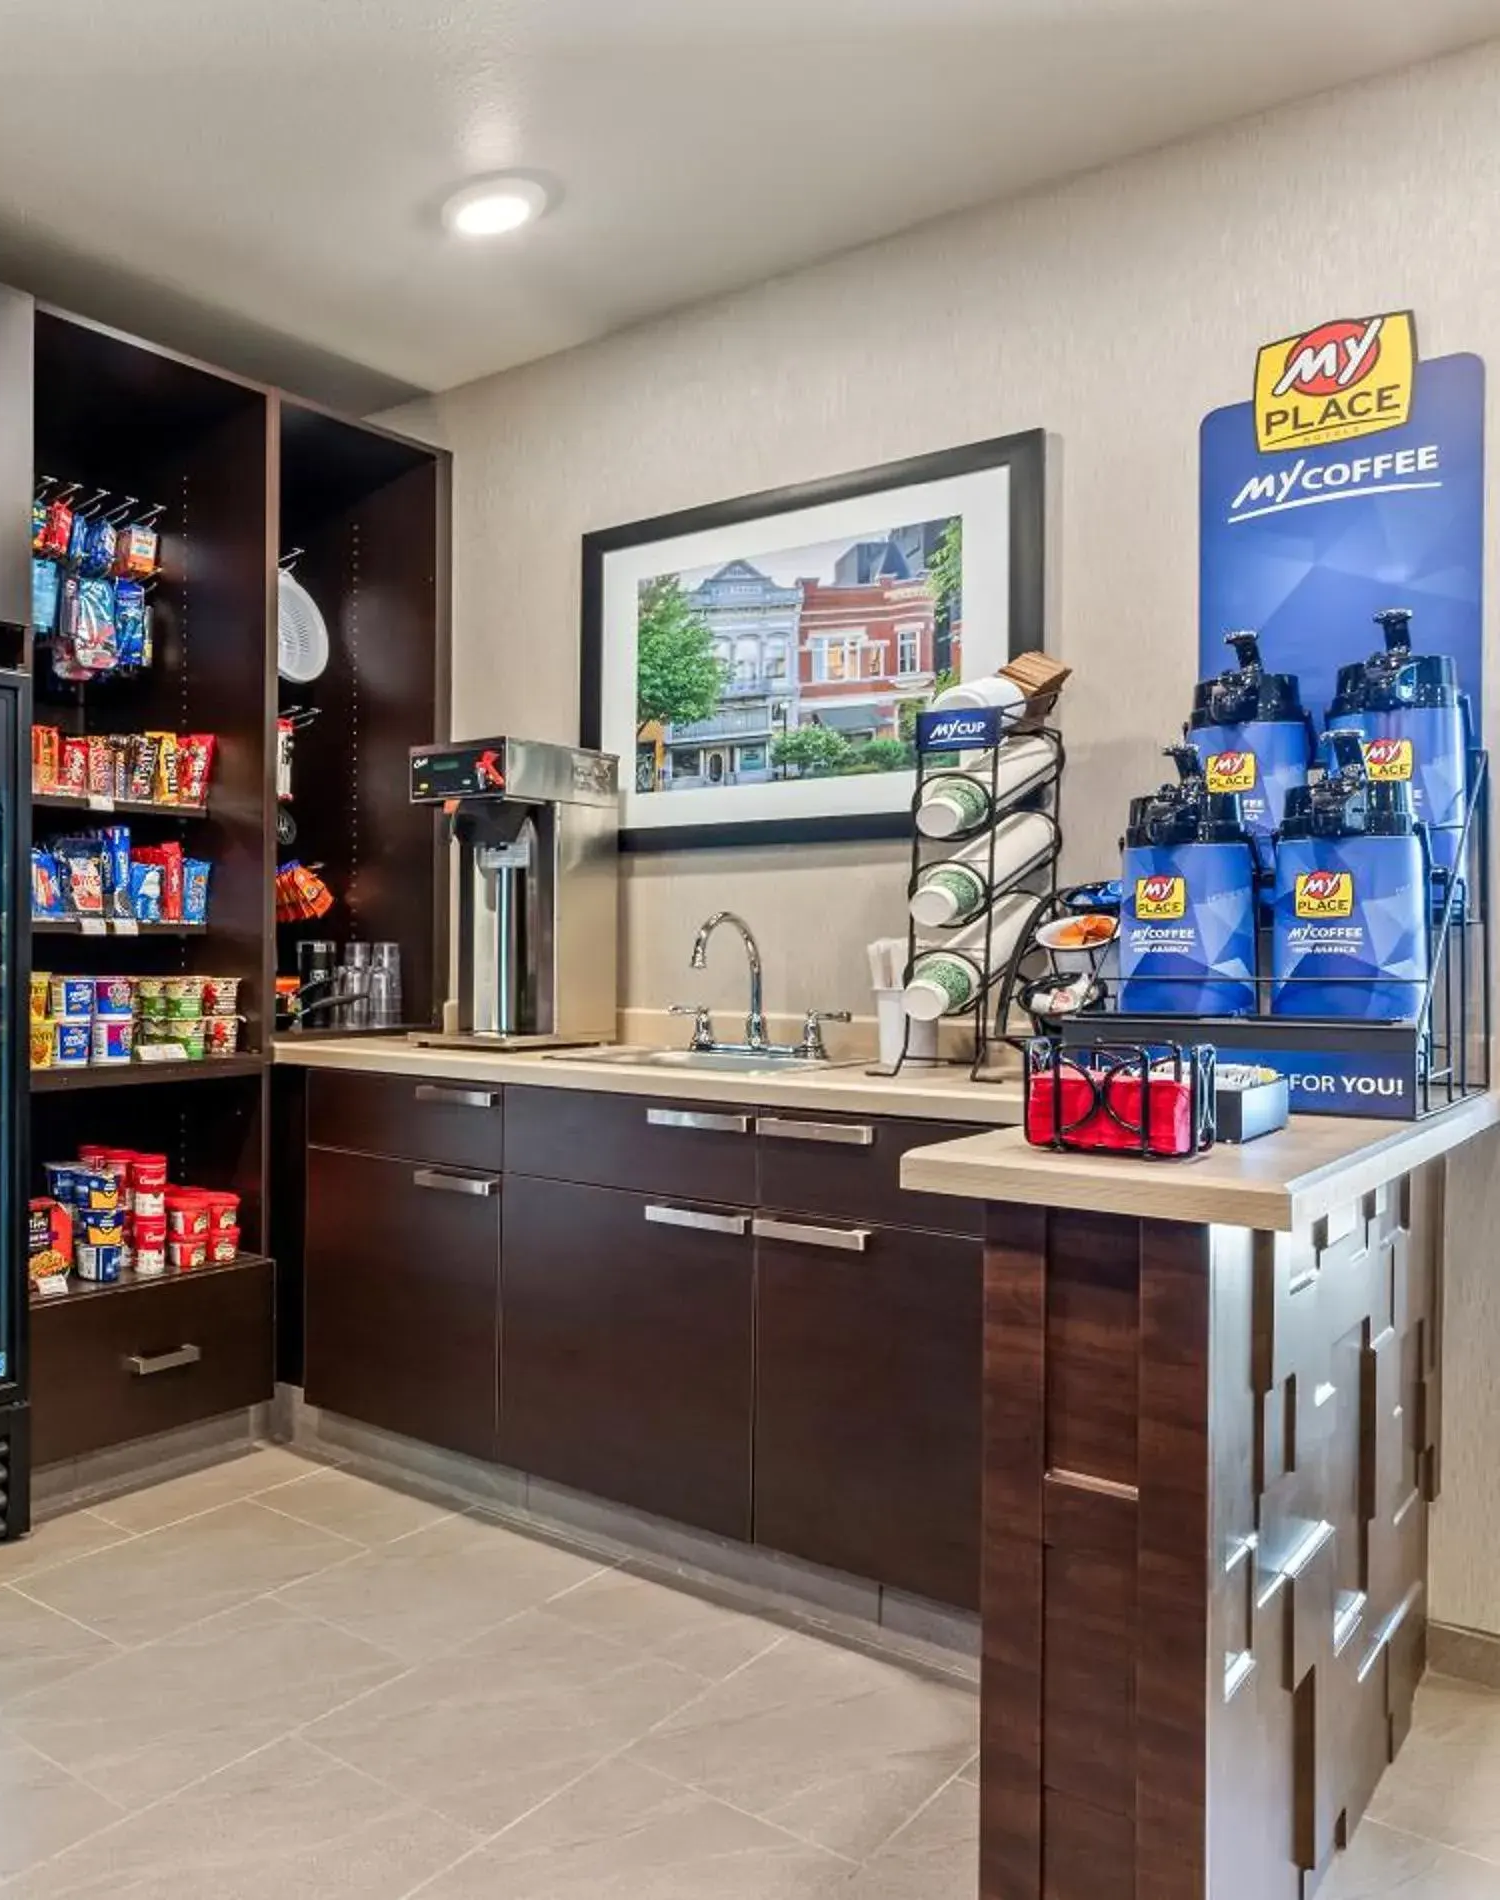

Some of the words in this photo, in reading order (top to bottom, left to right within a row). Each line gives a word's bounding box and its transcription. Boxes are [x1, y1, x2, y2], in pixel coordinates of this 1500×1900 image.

[1271, 316, 1385, 397] MY
[1264, 384, 1402, 436] PLACE
[1366, 740, 1400, 762] MY
[1214, 753, 1246, 773] MY
[1369, 763, 1410, 776] LACE
[1208, 775, 1252, 787] PLACE
[1142, 877, 1175, 900] MY
[1303, 874, 1341, 896] MY
[1138, 902, 1181, 914] PLACE
[1297, 899, 1348, 911] PLACE
[1151, 945, 1190, 953] ARABICA
[1288, 1074, 1335, 1093] FOR
[1340, 1076, 1403, 1096] YOU!
